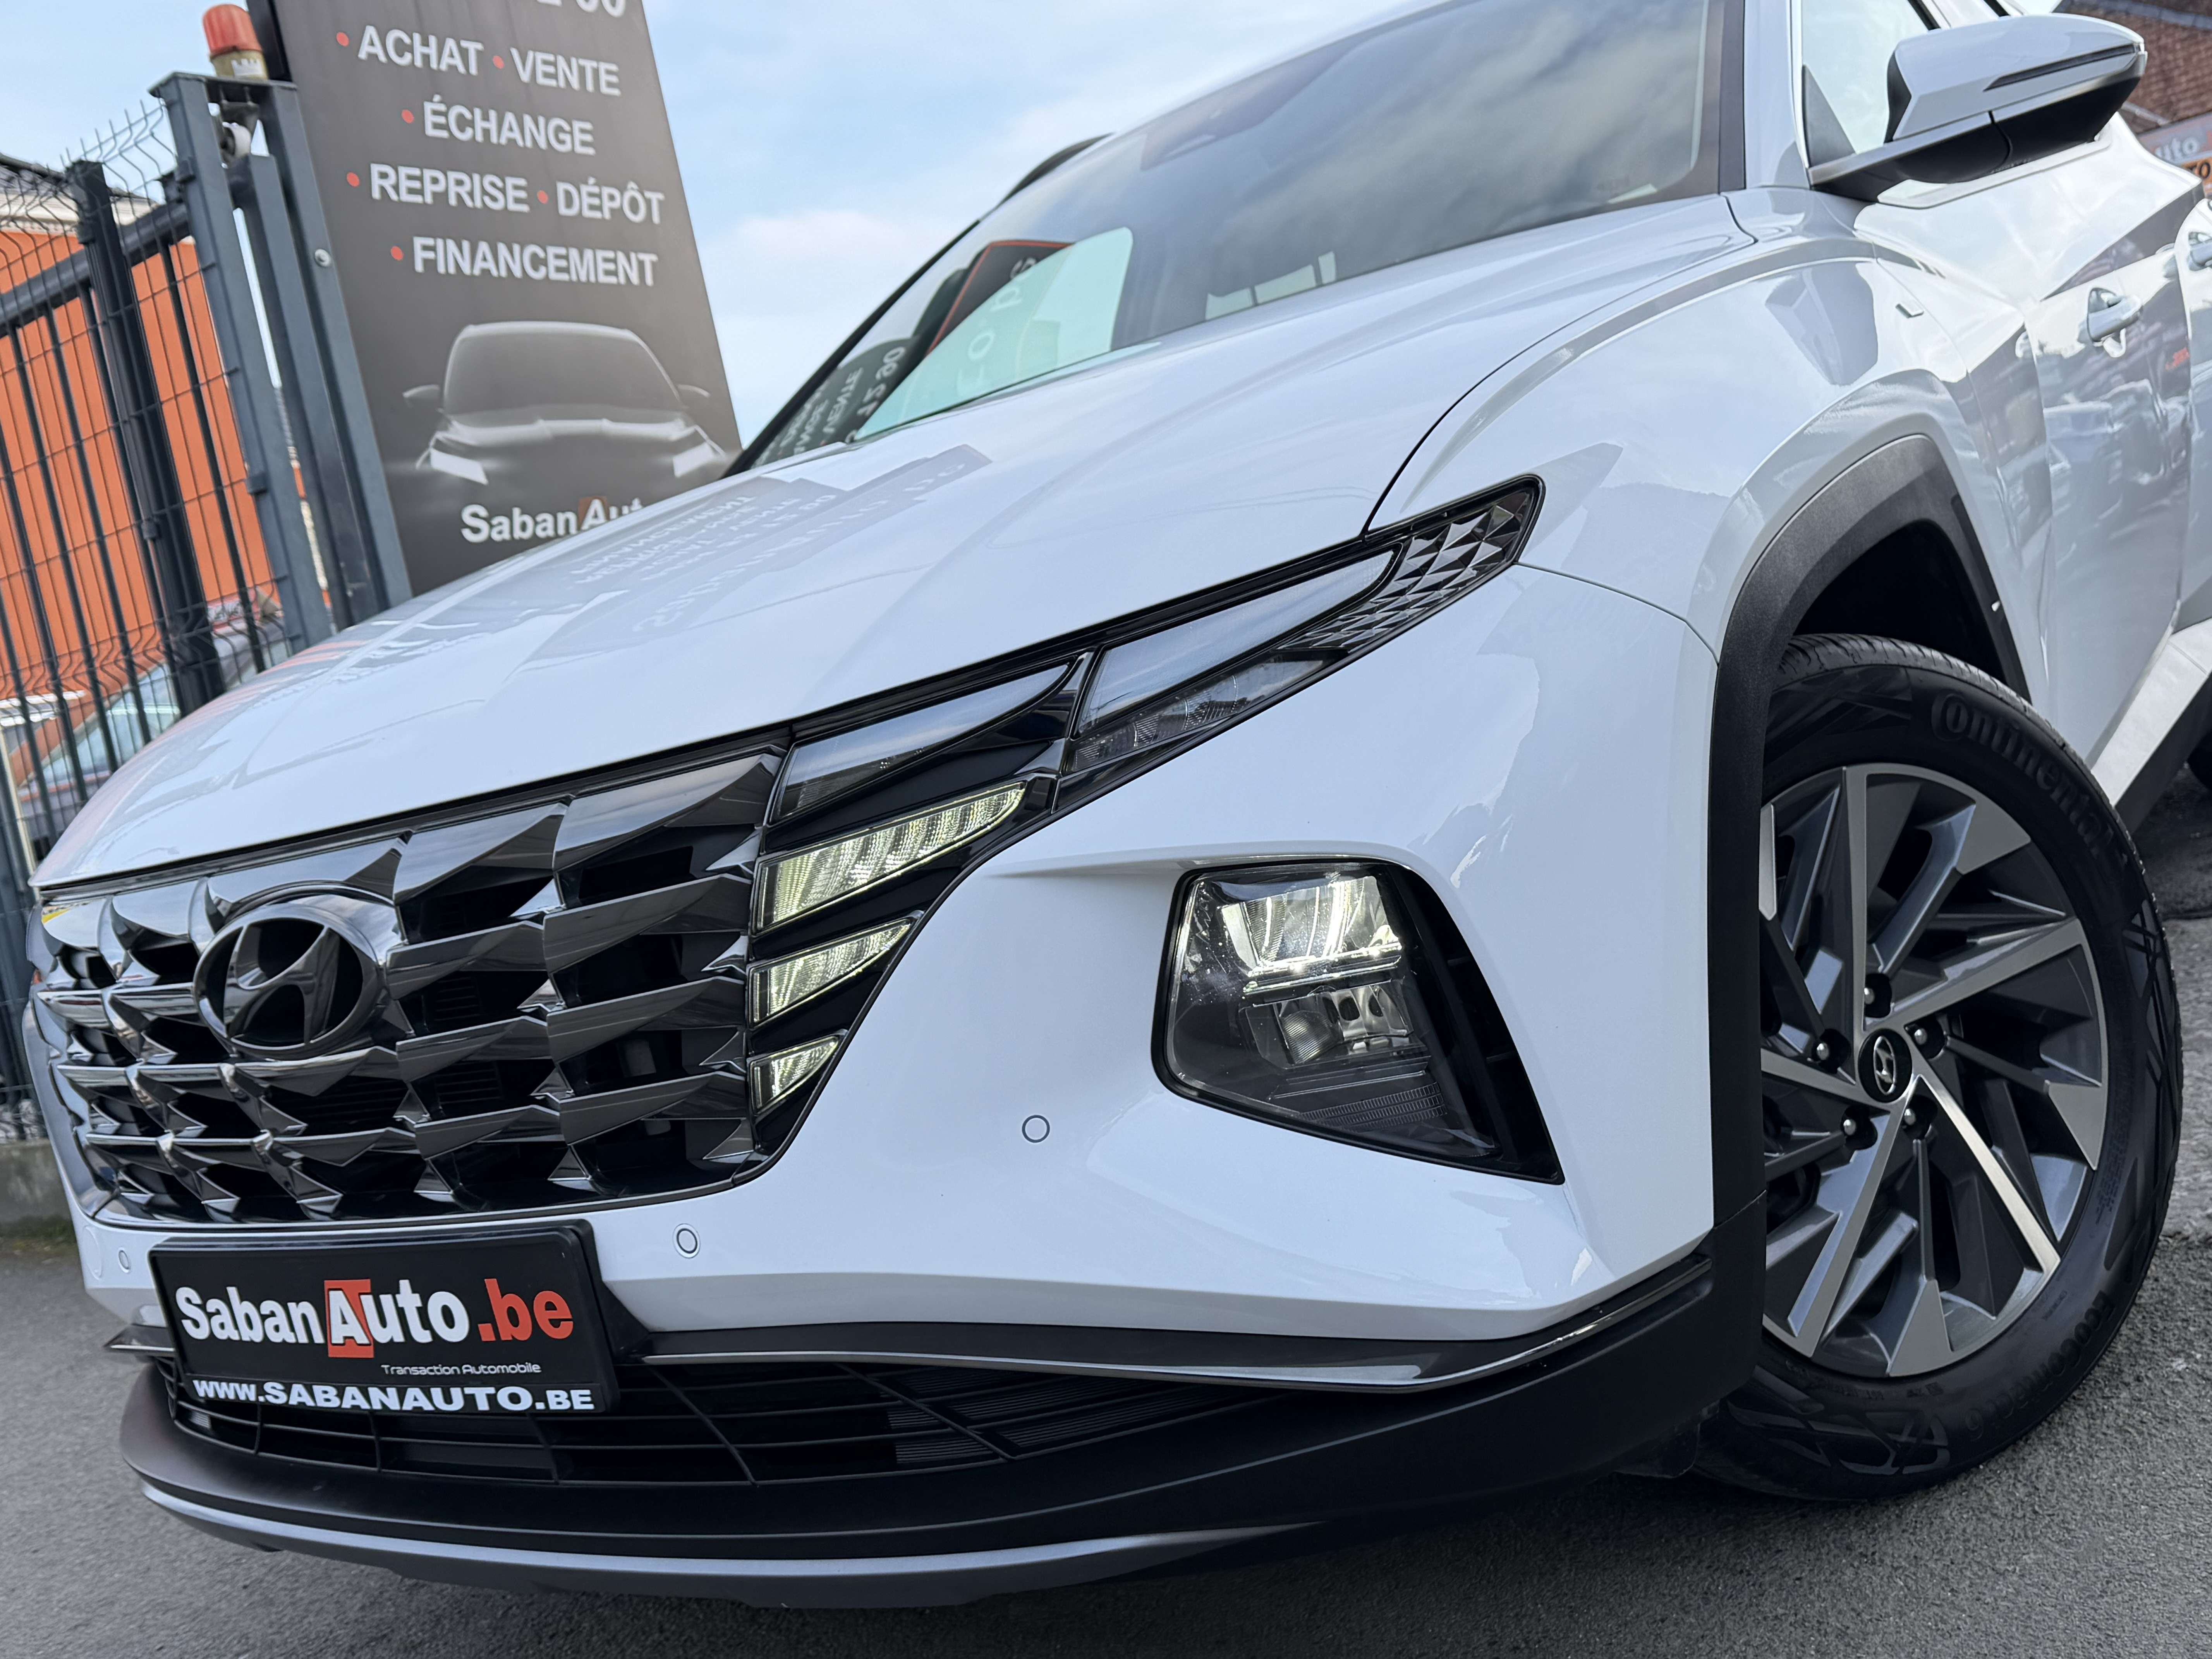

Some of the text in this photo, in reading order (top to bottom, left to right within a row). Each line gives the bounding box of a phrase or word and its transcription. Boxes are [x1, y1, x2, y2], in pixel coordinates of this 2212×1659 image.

[357, 25, 622, 96] ACHAT VENTE
[423, 94, 596, 156] ÉCHANGE
[370, 163, 665, 225] REPRISE DÉPÔT
[413, 236, 658, 287] FINANCEMENT
[381, 1362, 541, 1375] Transaction Automobile
